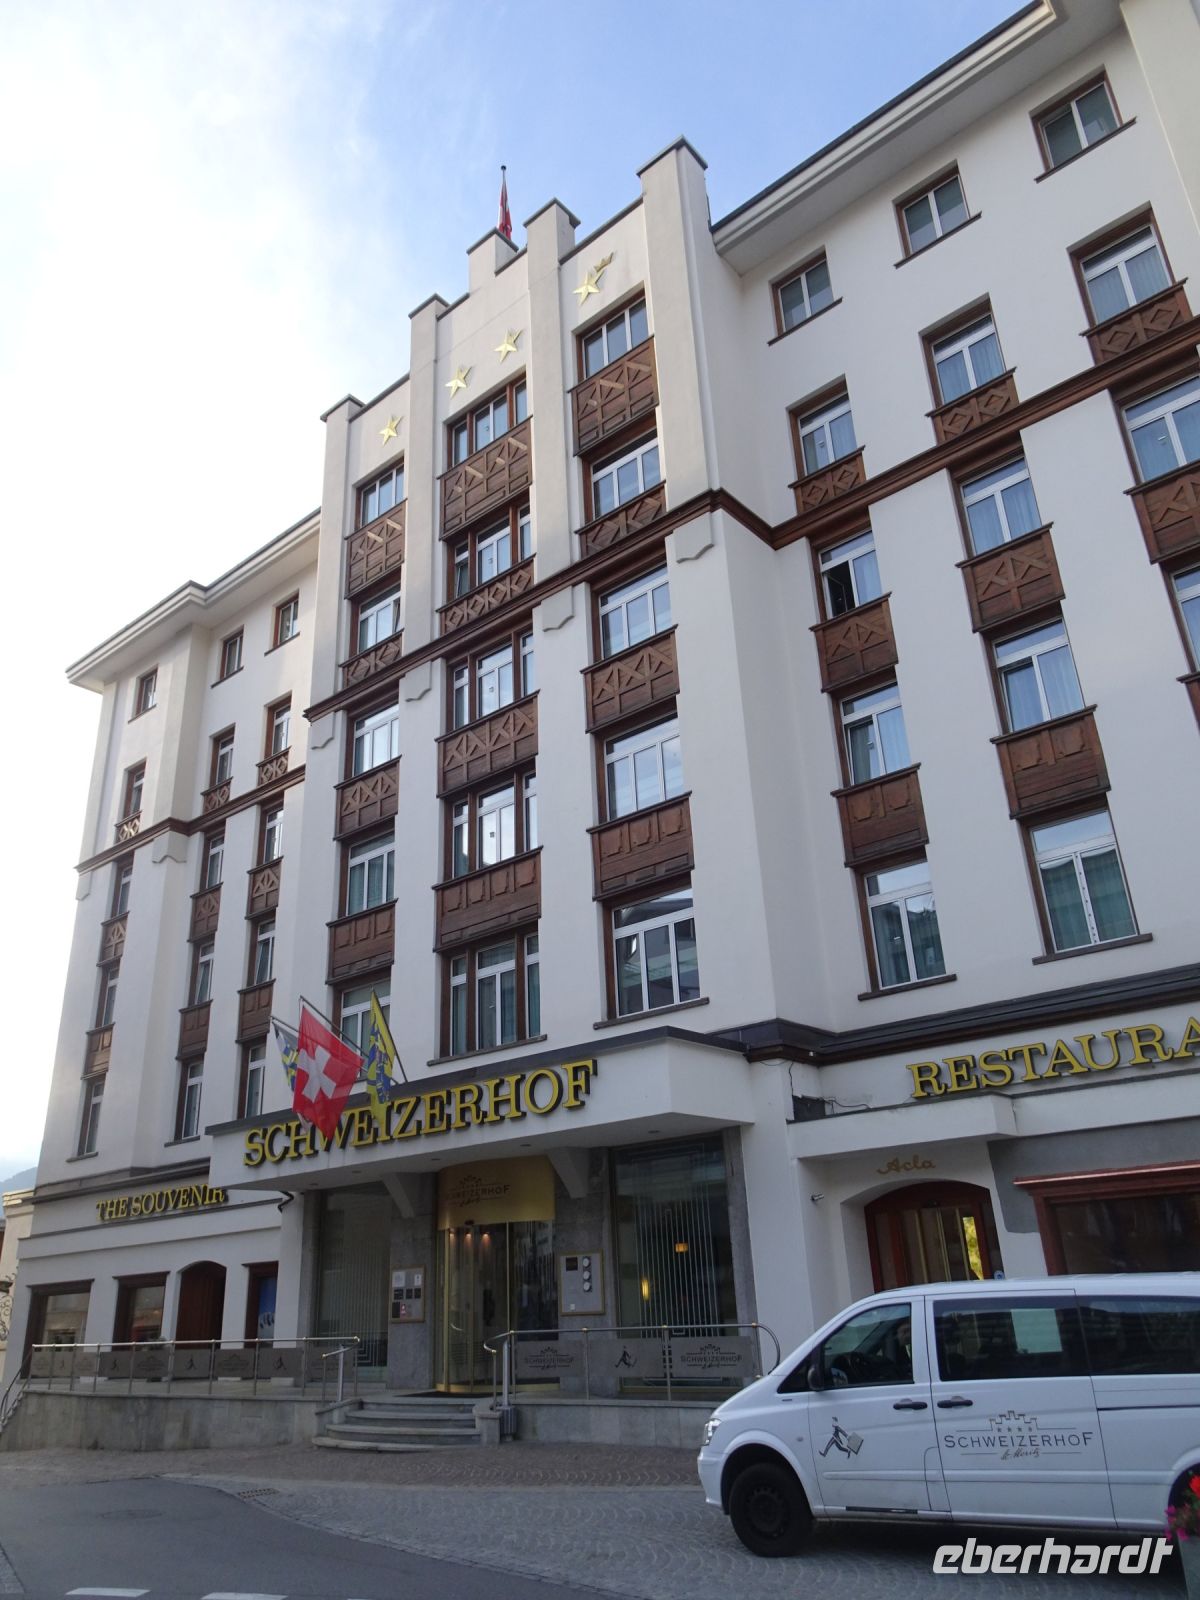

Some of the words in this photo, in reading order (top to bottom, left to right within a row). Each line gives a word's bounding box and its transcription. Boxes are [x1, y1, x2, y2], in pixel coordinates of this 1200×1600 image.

[876, 1154, 936, 1174] Acla
[96, 1197, 129, 1221] THE
[130, 1184, 227, 1216] SOUVENIR
[944, 1432, 1093, 1448] SCHWEIZERHOF
